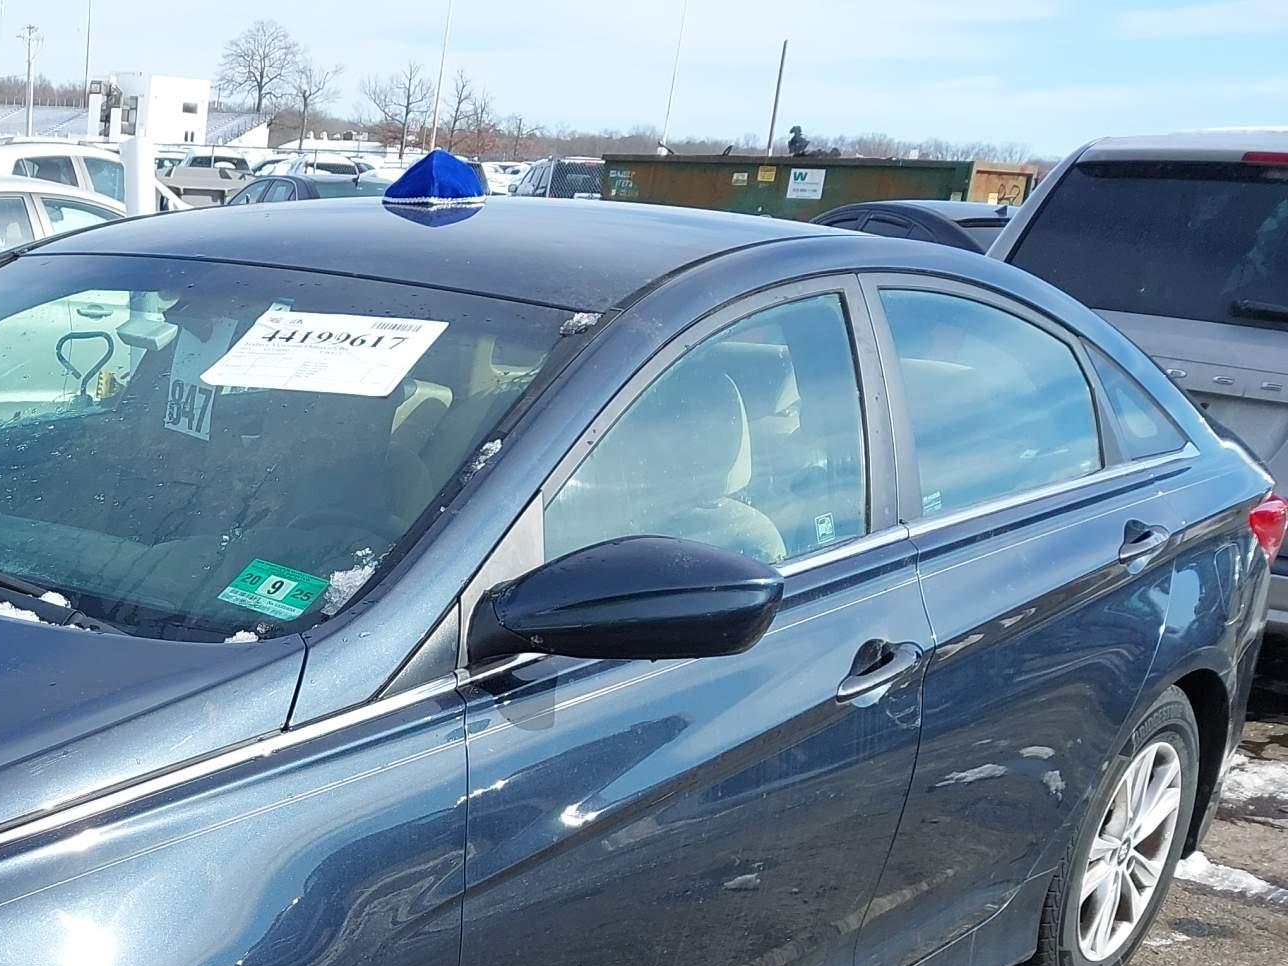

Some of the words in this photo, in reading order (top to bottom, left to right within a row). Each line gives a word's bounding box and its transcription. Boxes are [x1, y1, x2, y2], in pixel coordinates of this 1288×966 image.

[261, 329, 409, 350] 44199617
[166, 379, 214, 433] 847
[241, 573, 262, 586] 20
[266, 580, 285, 595] 9
[291, 589, 314, 602] 25
